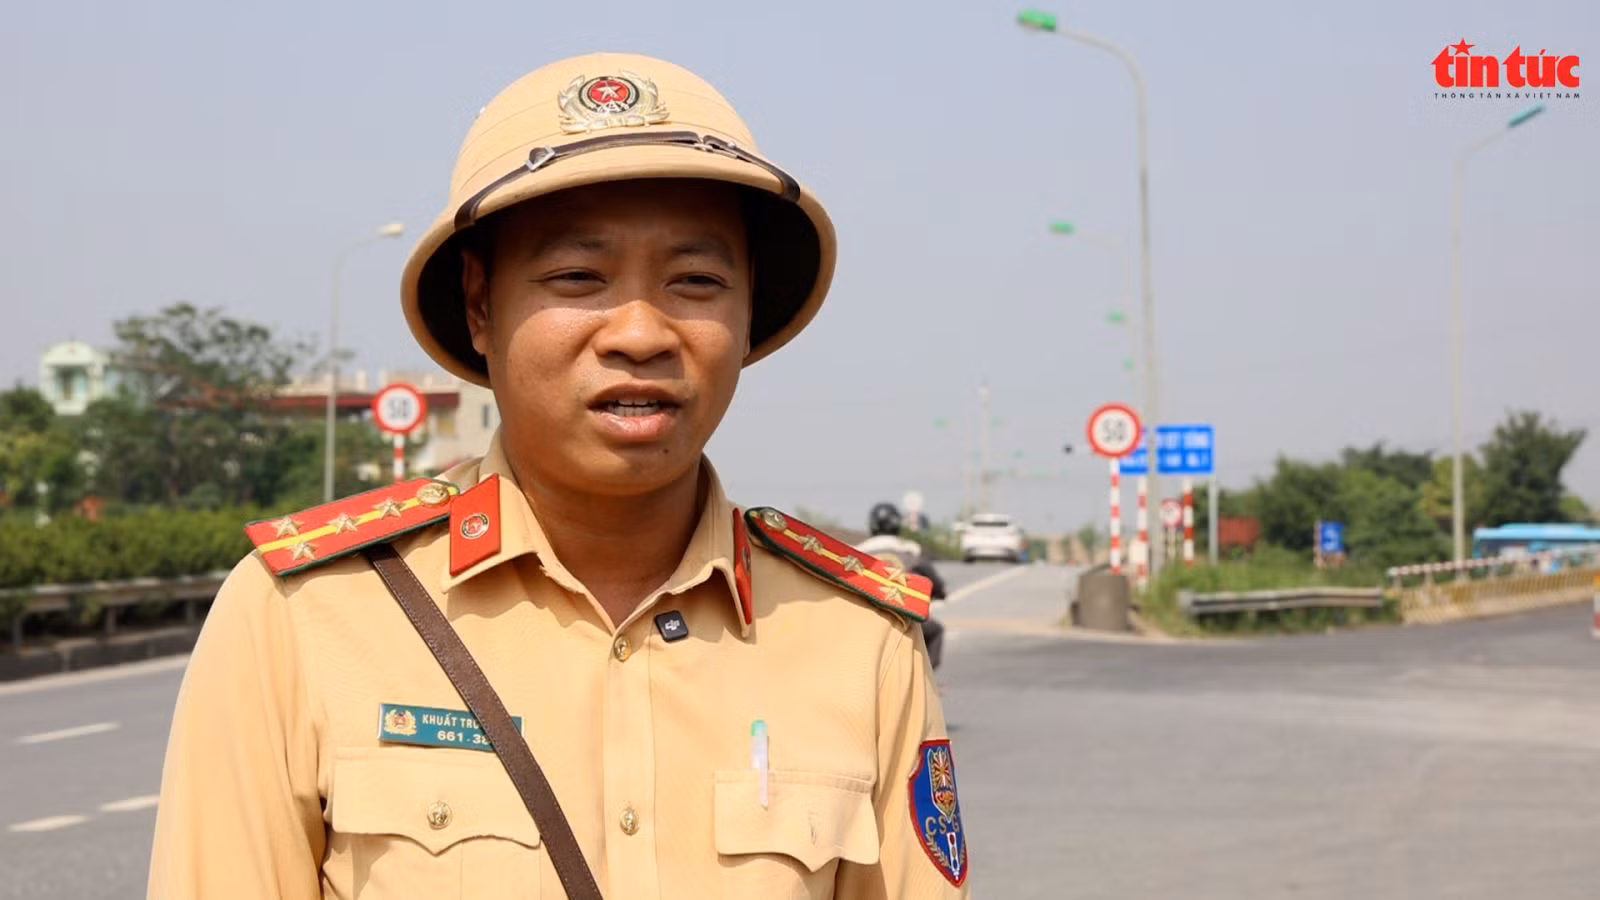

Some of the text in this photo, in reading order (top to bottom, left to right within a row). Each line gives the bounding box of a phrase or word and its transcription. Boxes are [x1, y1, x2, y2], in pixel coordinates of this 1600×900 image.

[388, 397, 411, 419] 50
[1102, 418, 1128, 444] 50
[460, 717, 480, 729] TRU
